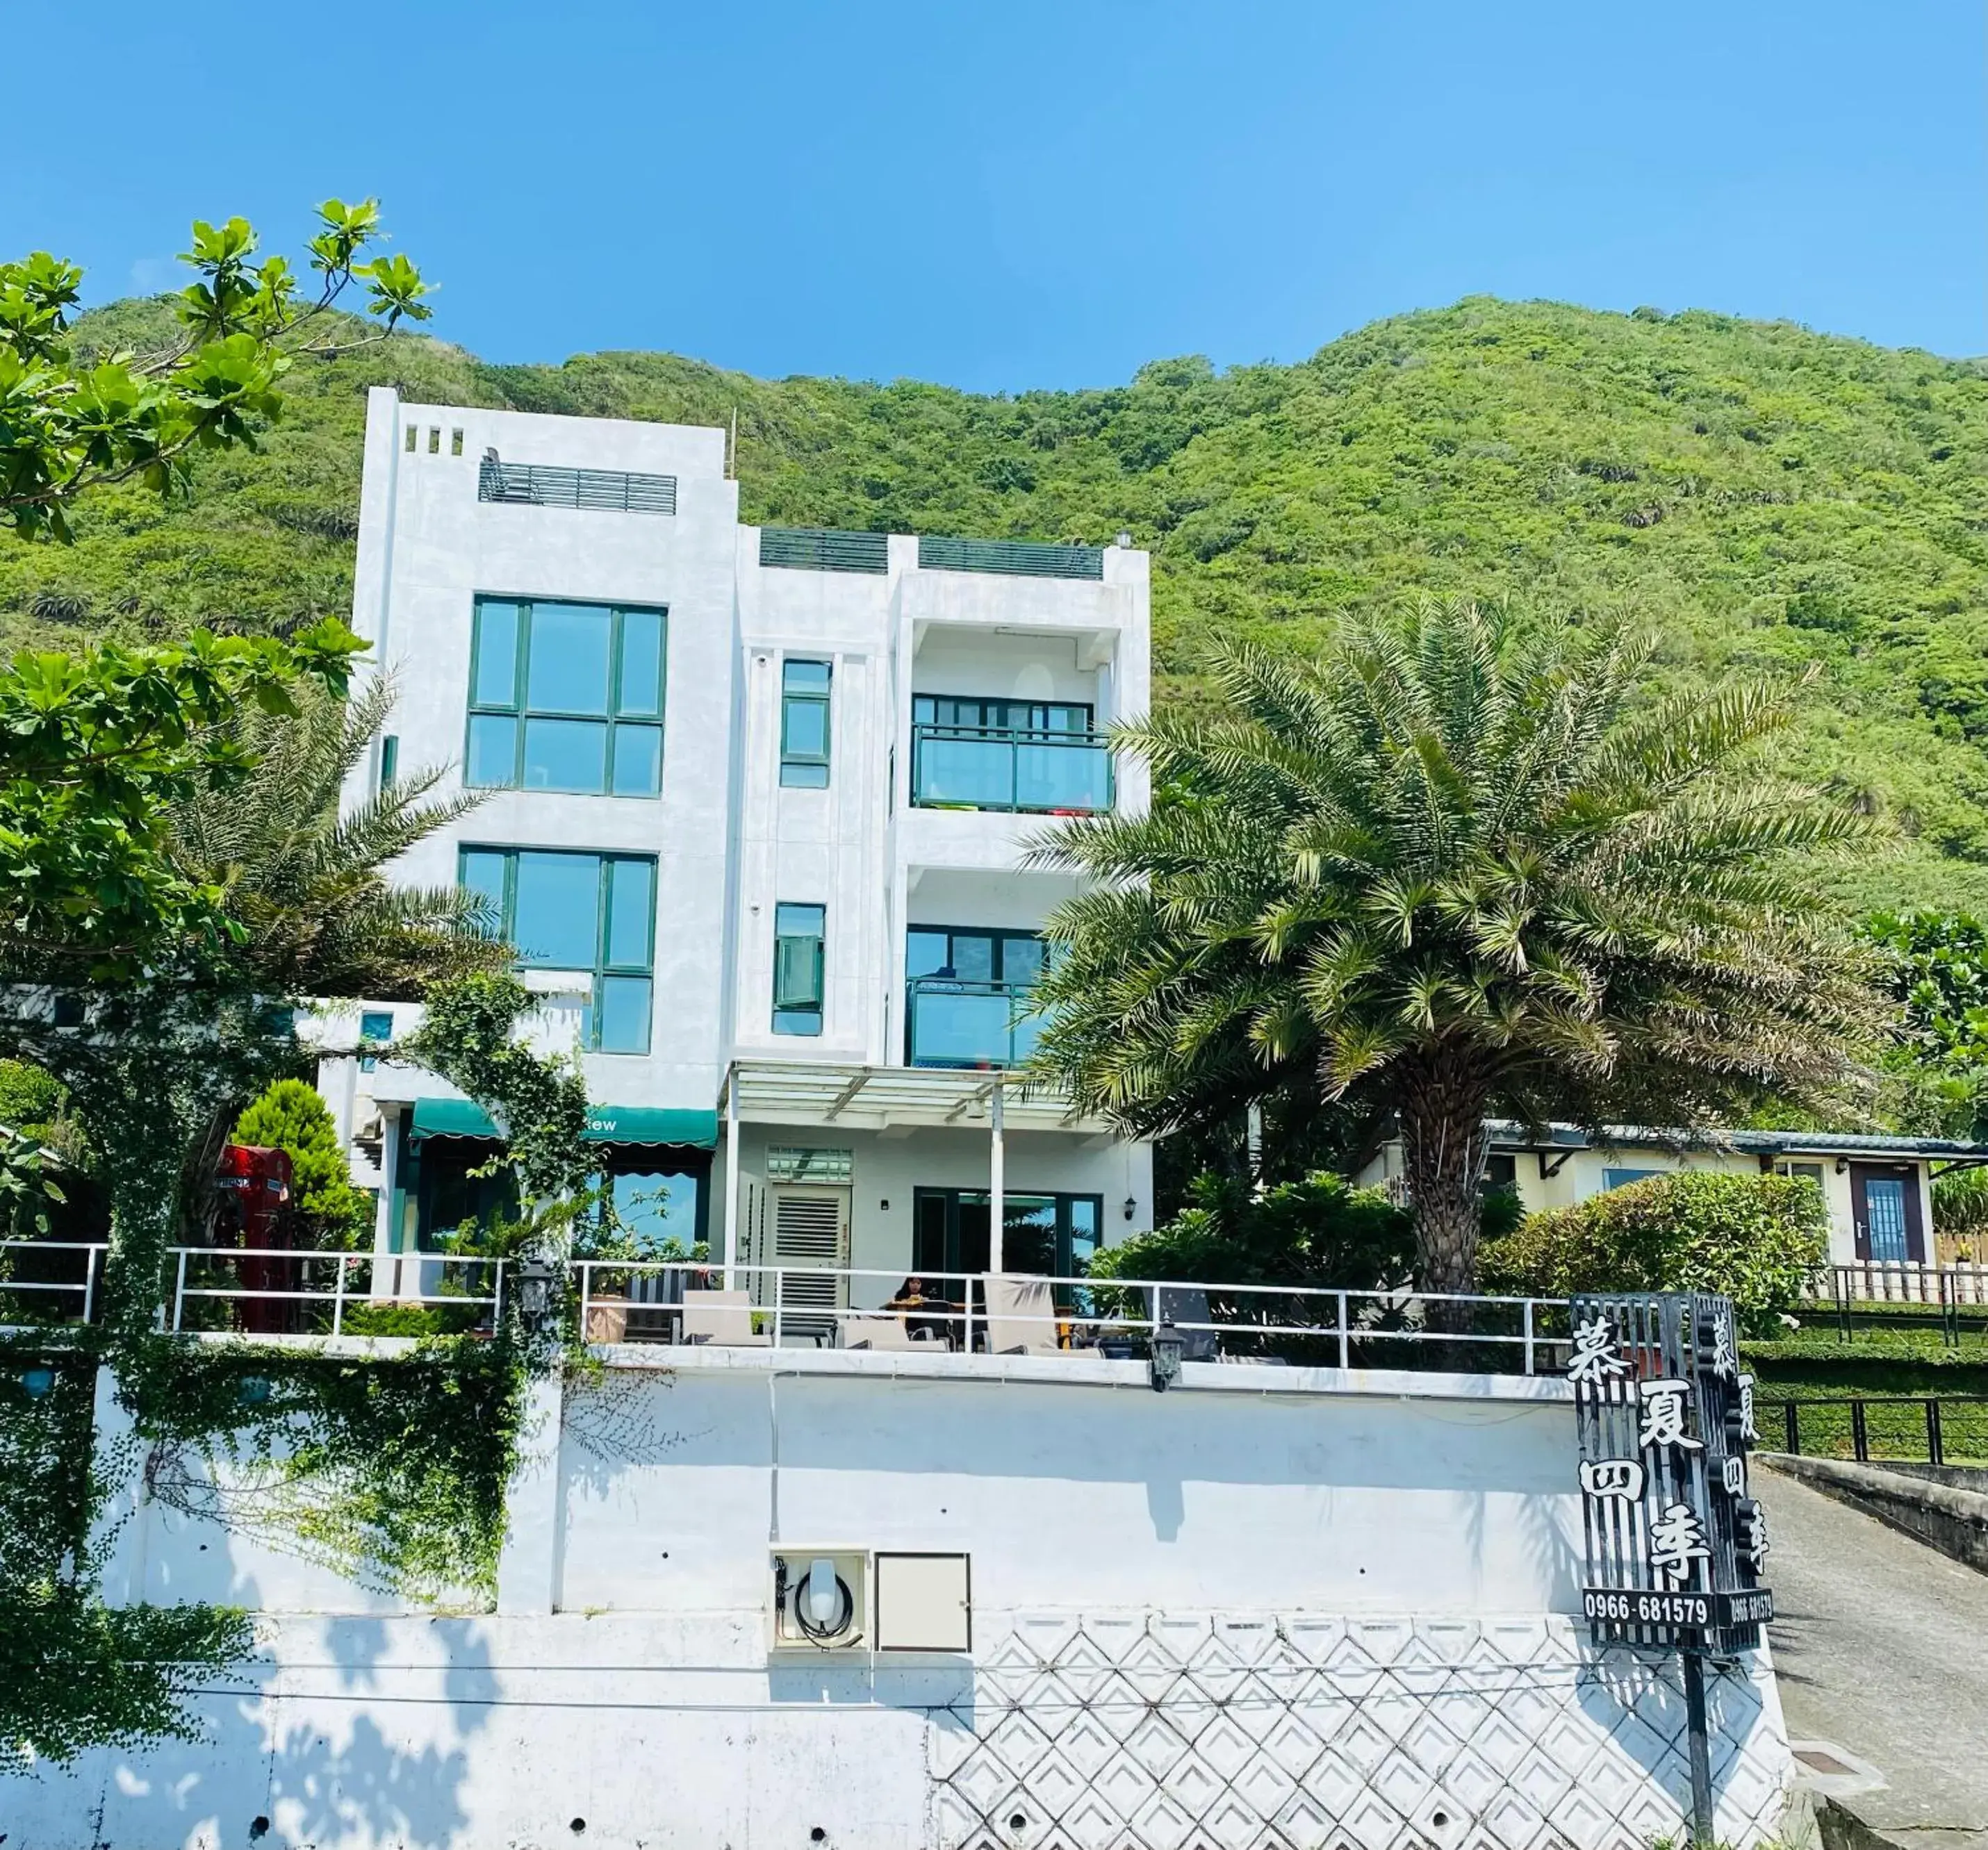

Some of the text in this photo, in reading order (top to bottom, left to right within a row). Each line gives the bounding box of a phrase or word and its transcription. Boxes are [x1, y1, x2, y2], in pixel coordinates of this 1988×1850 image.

[1567, 1315, 1710, 1580] 慕夏四季
[1712, 1312, 1769, 1575] 慕夏四季
[1585, 1594, 1707, 1624] 0966-681579
